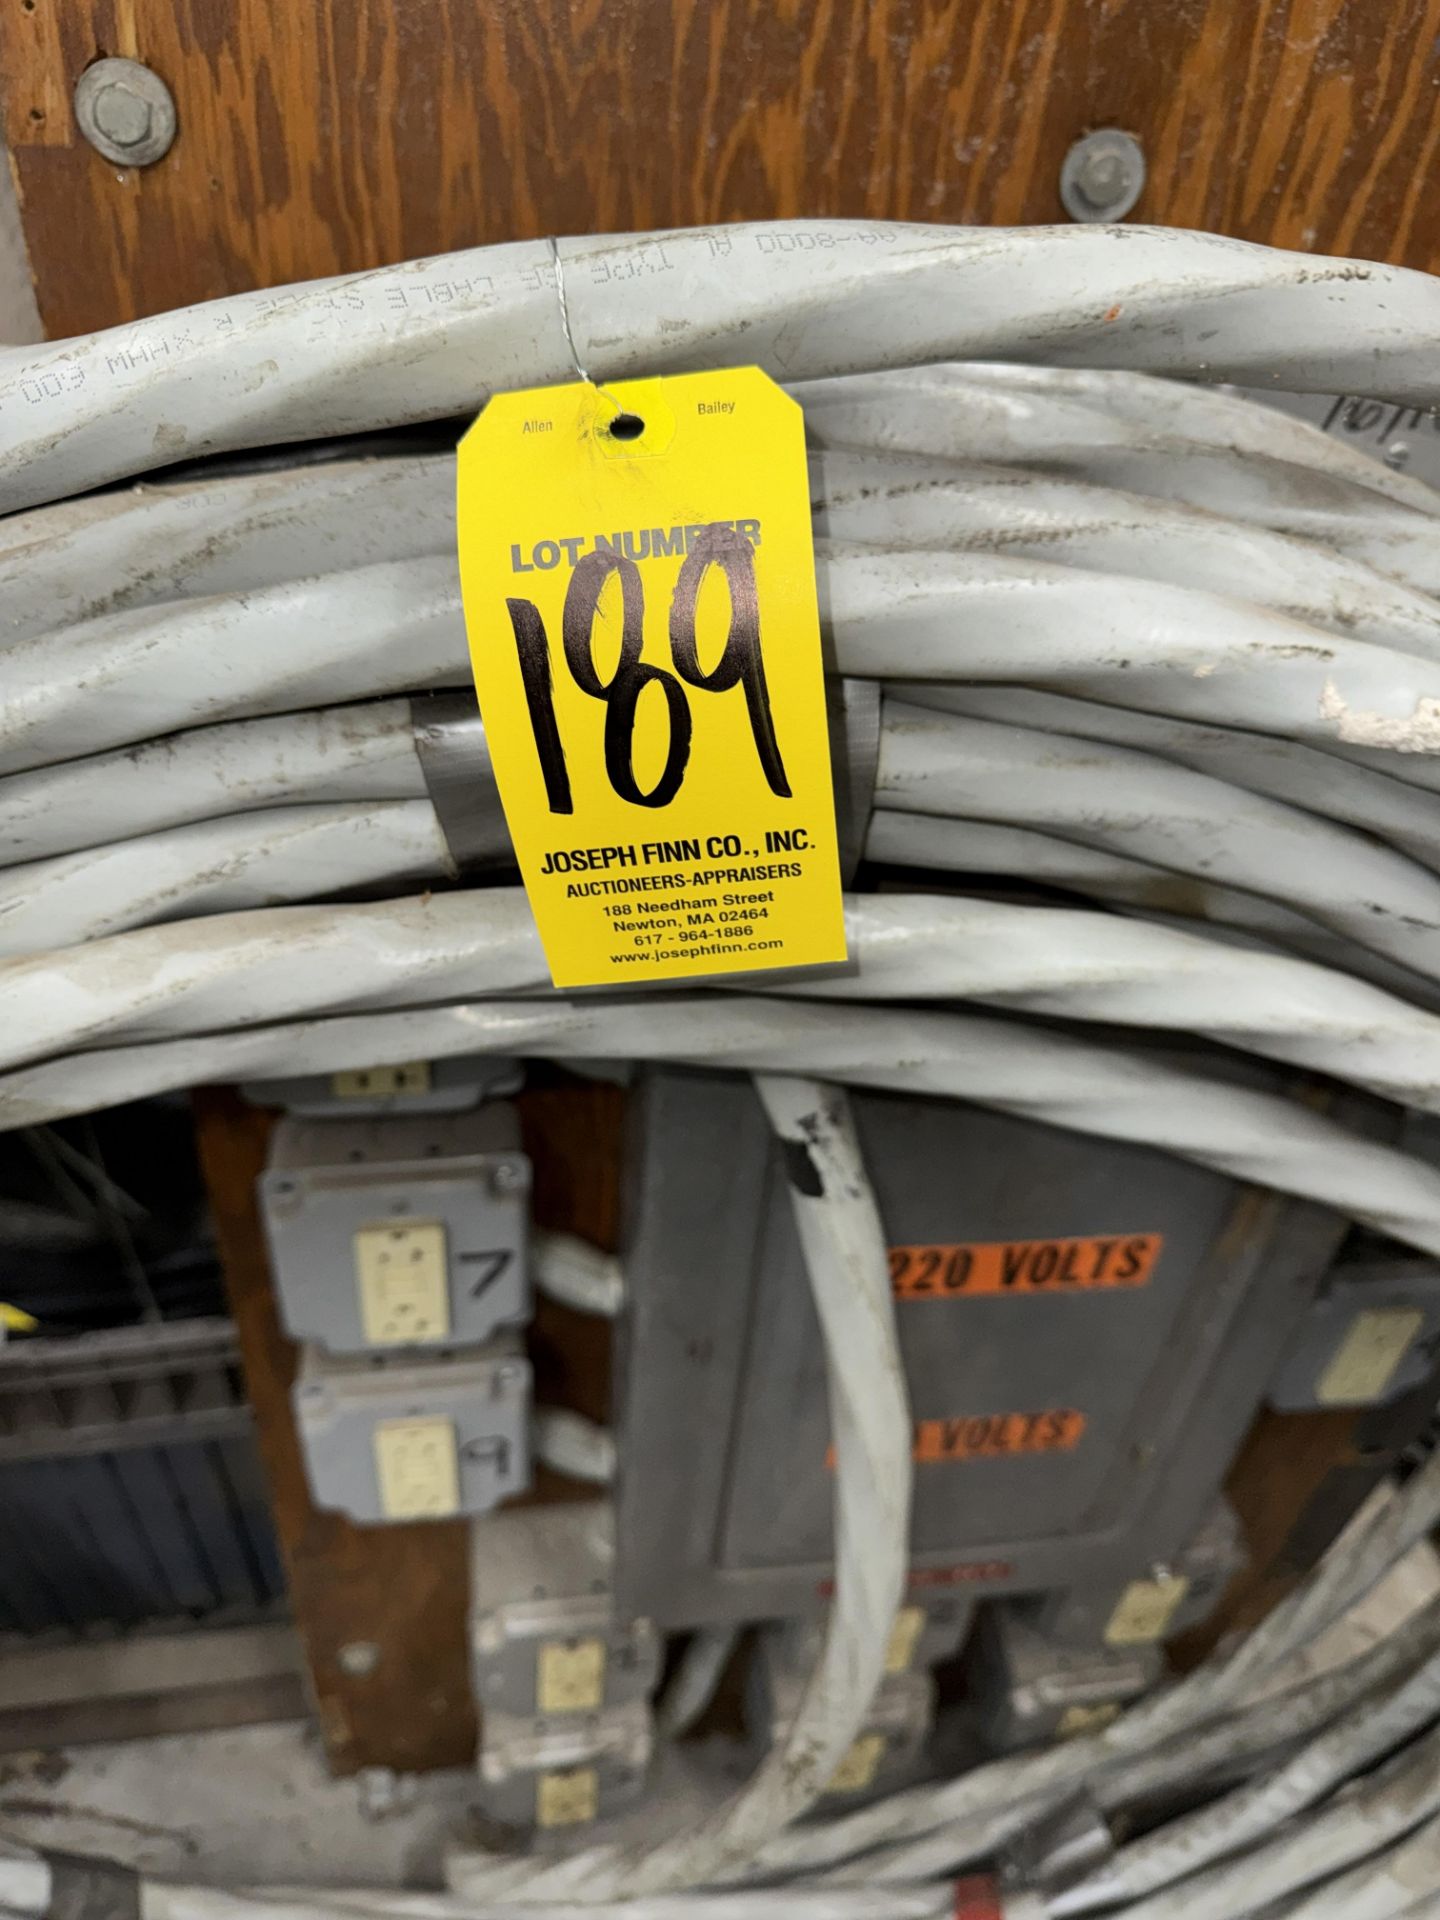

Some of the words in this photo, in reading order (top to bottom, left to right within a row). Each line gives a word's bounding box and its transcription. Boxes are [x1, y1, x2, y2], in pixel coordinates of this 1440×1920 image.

[590, 241, 675, 284] TYPE
[697, 401, 736, 416] Bailey
[522, 420, 553, 434] Allen
[511, 537, 585, 573] LOT
[506, 521, 793, 815] 189
[541, 845, 638, 875] JOSEPH
[641, 838, 701, 866] FINN
[705, 834, 759, 859] CO.,
[764, 828, 816, 853] INC.
[566, 862, 802, 898] AUCTIONEERS-APPRAISERS
[602, 904, 632, 917] 188
[637, 897, 718, 914] Needham
[722, 890, 774, 906] Street
[613, 916, 683, 932] Newton,
[687, 913, 714, 926] MA
[719, 907, 769, 922] 02464
[610, 937, 784, 964] www.josephfinn.com
[634, 932, 662, 946] 617
[678, 925, 754, 943] 964-1886
[458, 1248, 513, 1299] 7
[1002, 1238, 1149, 1286] VOLTS
[943, 1408, 1071, 1452] VOLTS
